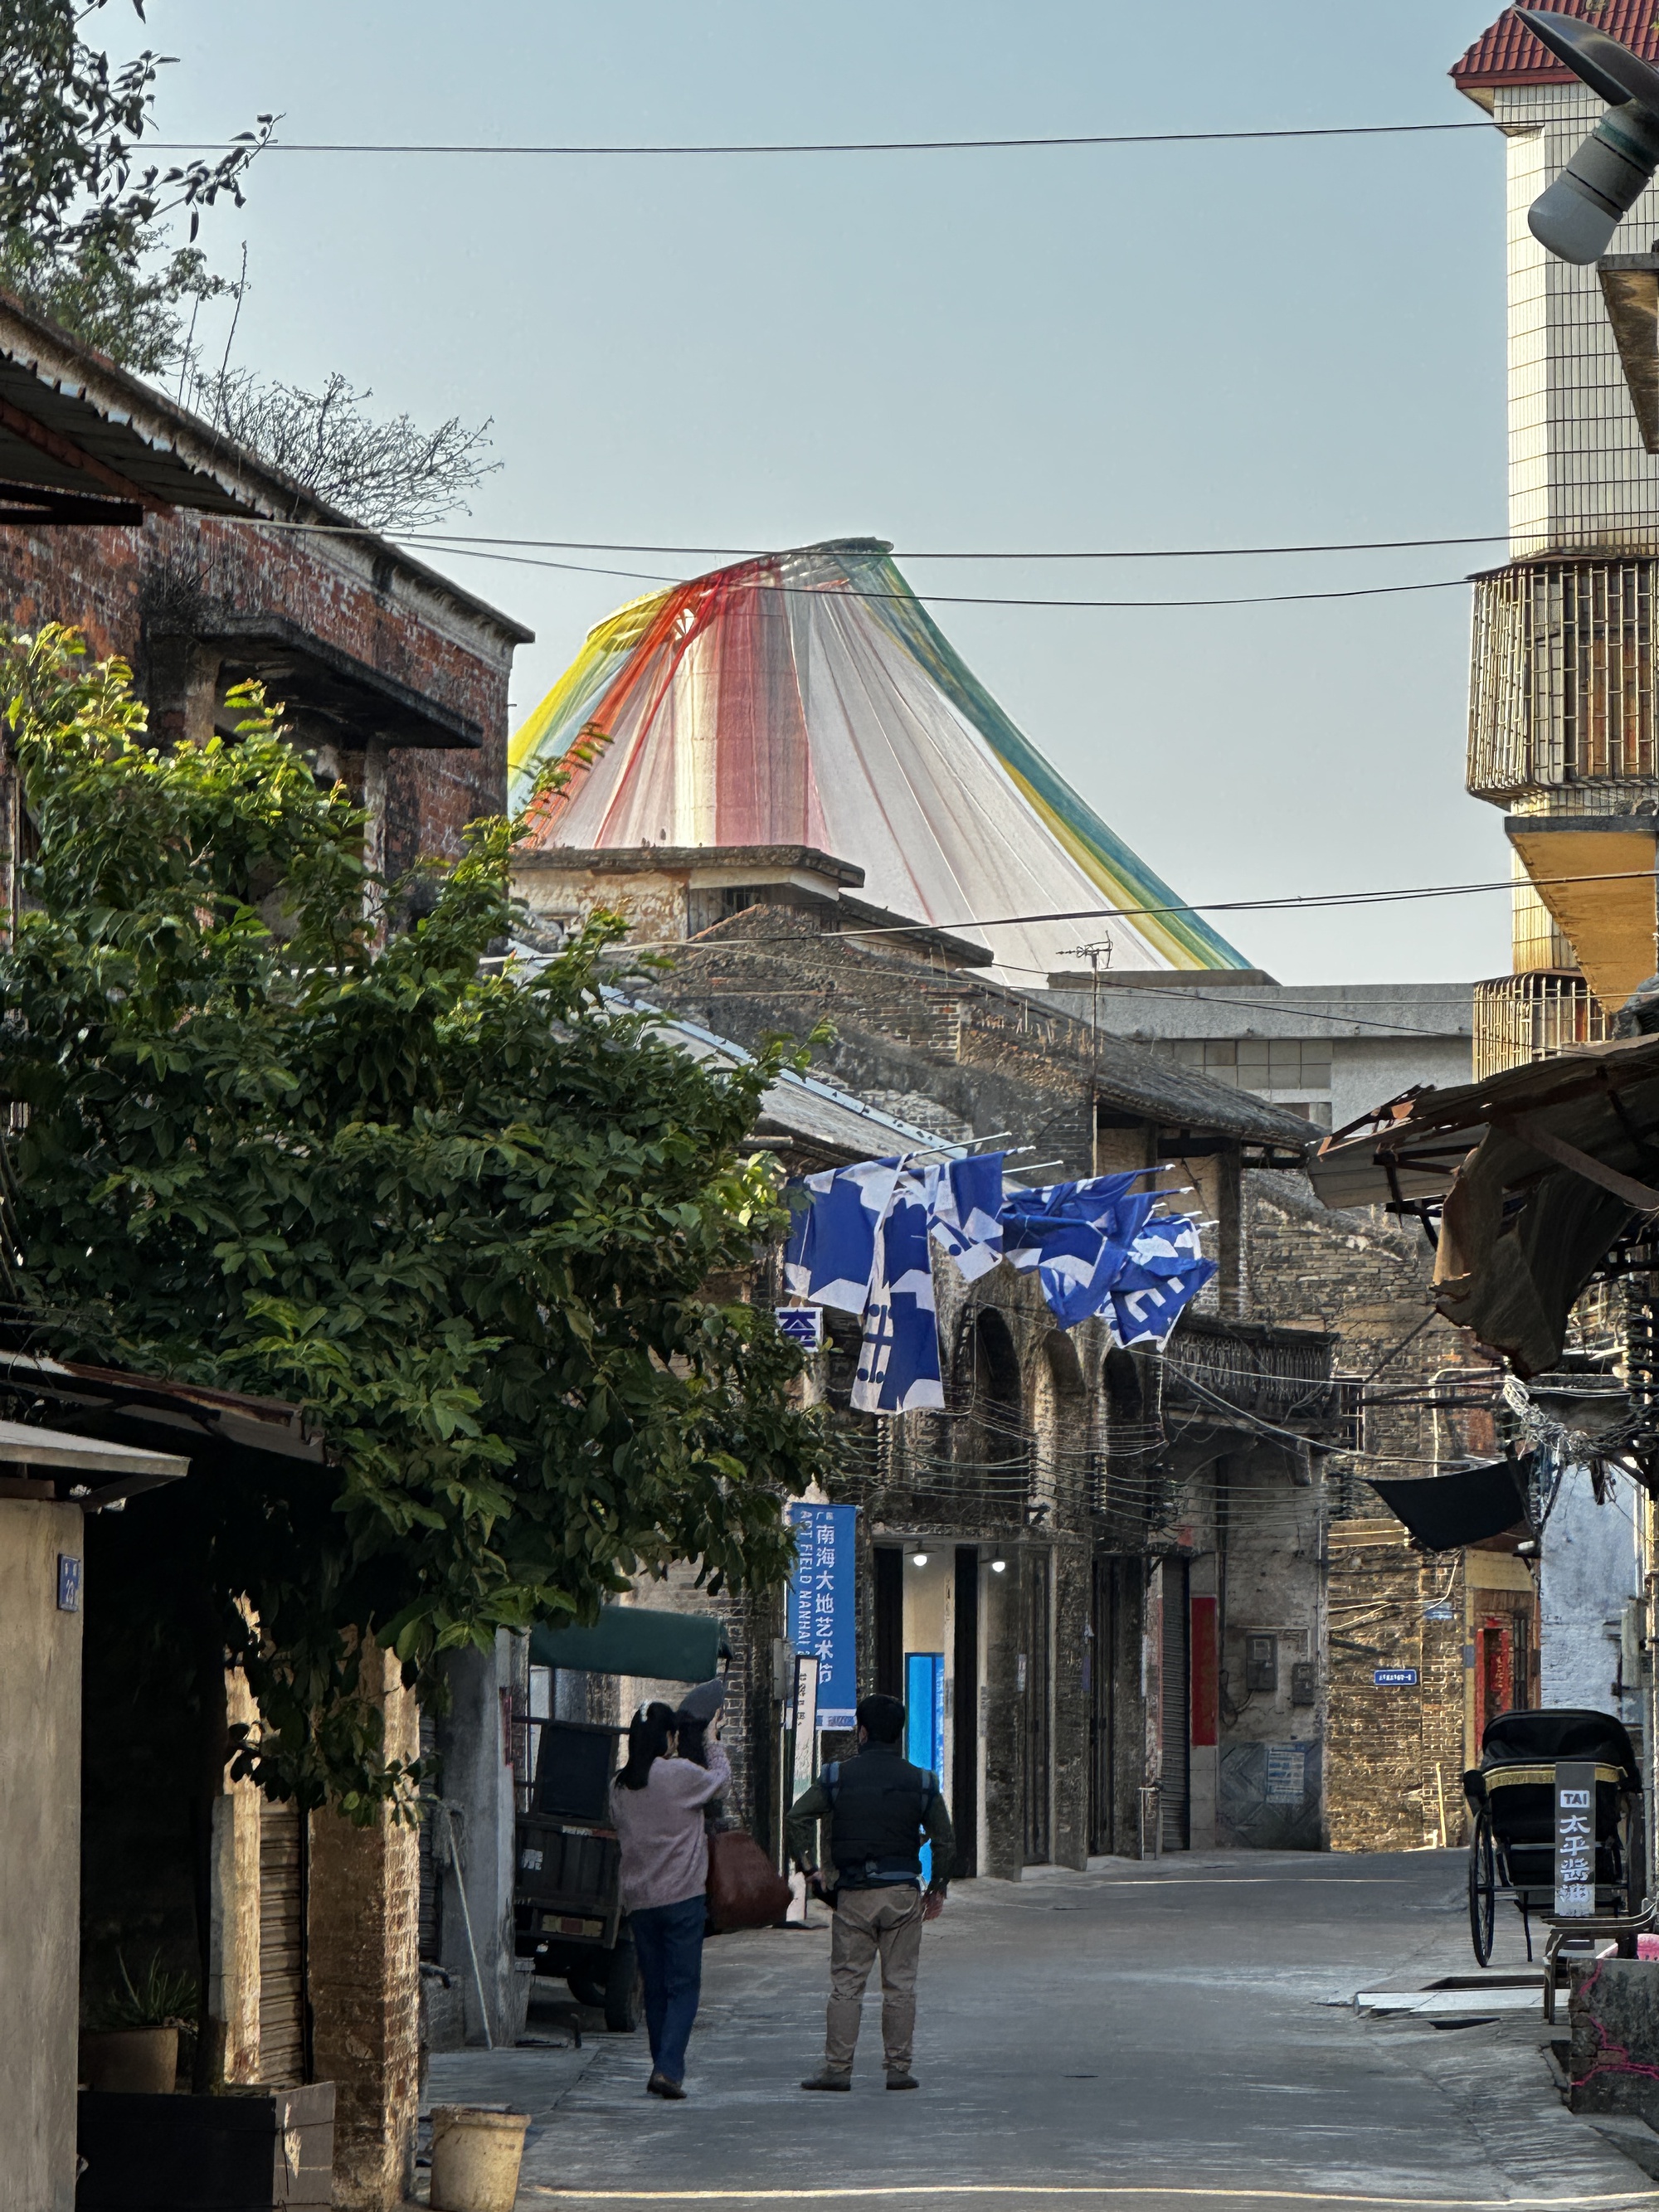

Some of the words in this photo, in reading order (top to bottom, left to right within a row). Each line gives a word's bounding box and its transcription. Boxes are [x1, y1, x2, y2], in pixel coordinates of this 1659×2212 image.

[799, 1544, 813, 1584] FIELD
[797, 1590, 812, 1646] NANHAI
[1563, 1793, 1587, 1806] TAI
